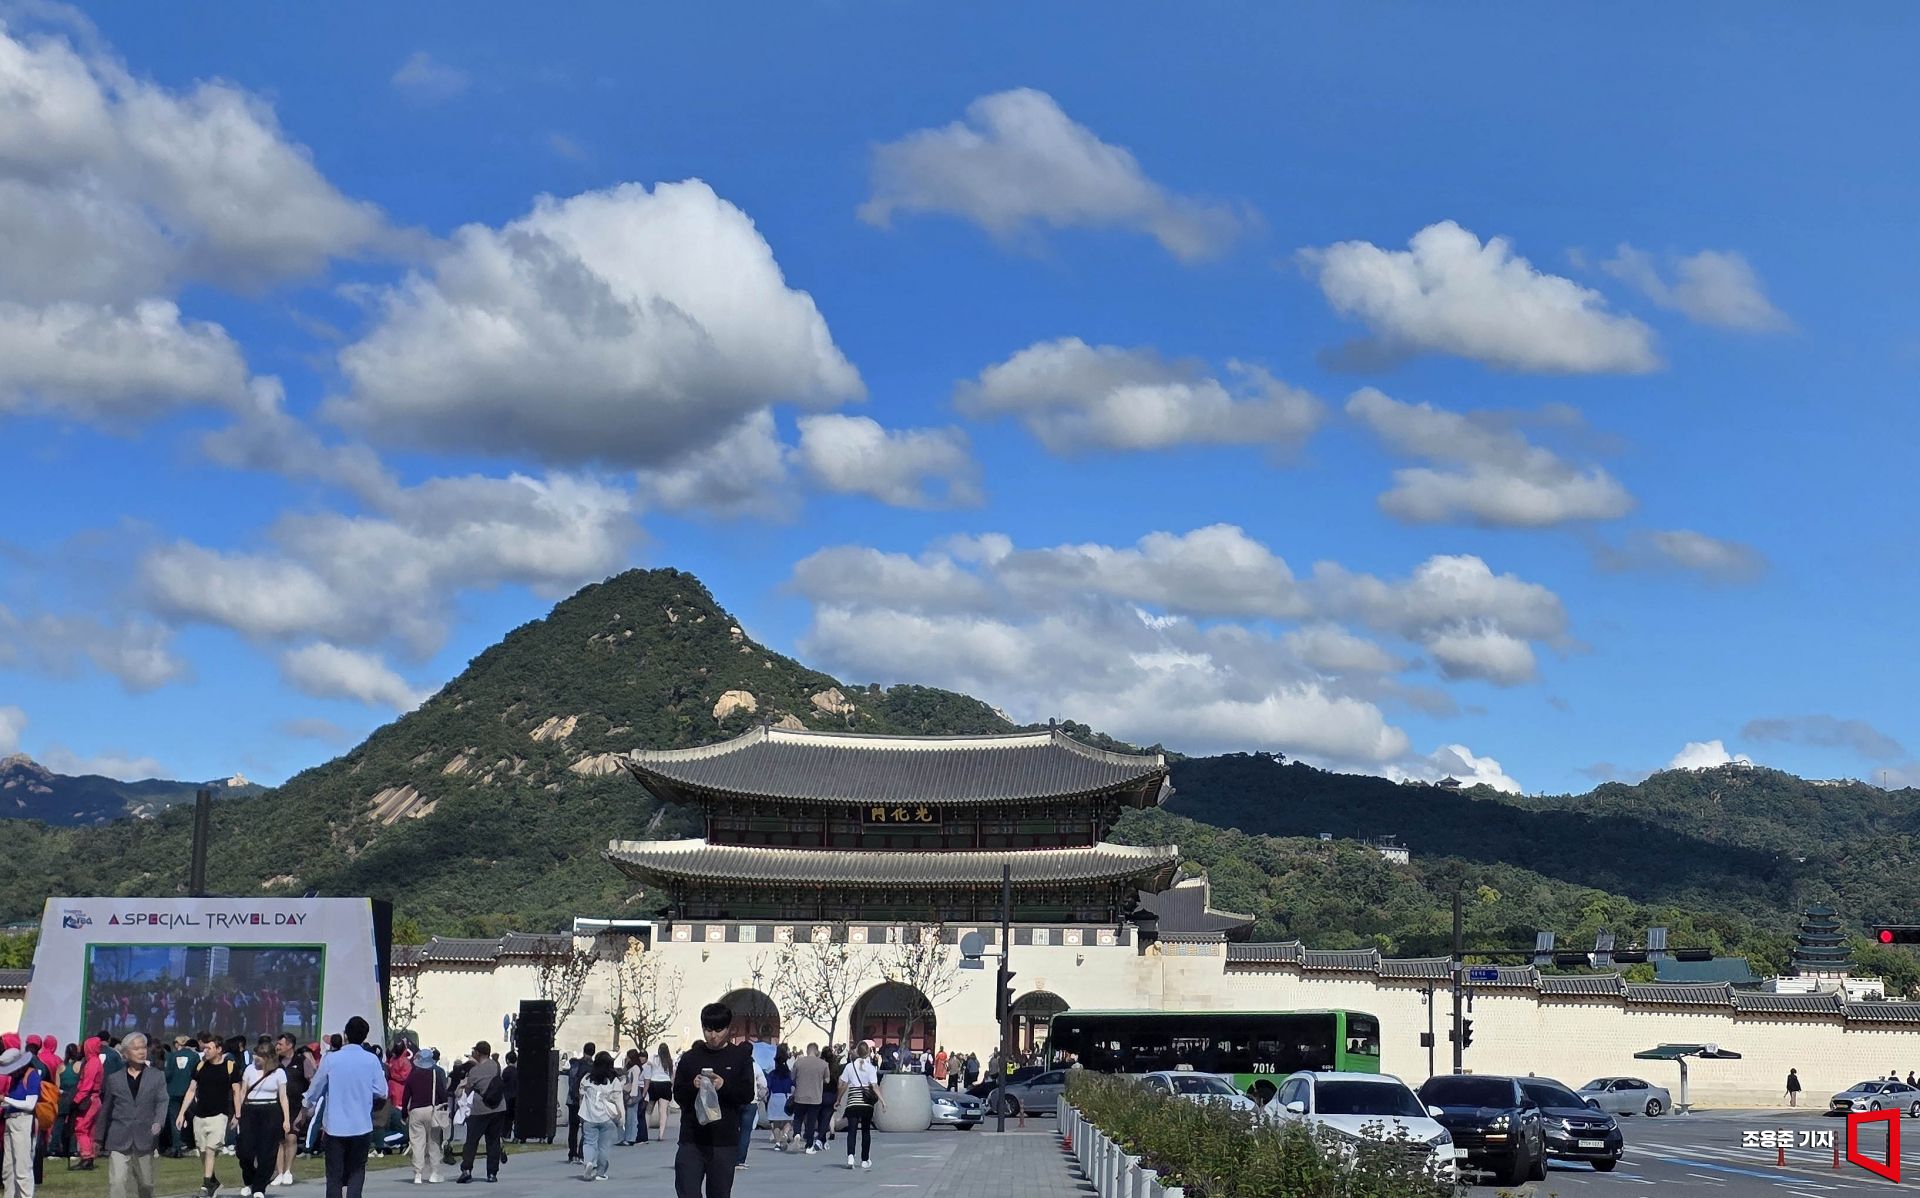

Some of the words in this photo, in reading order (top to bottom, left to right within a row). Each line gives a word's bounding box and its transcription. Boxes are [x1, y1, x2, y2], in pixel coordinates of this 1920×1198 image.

[108, 913, 119, 925] A
[122, 913, 200, 930] SPECIAL
[206, 913, 270, 929] TRAVEL
[275, 913, 307, 925] DAY
[1252, 1062, 1275, 1074] 7016
